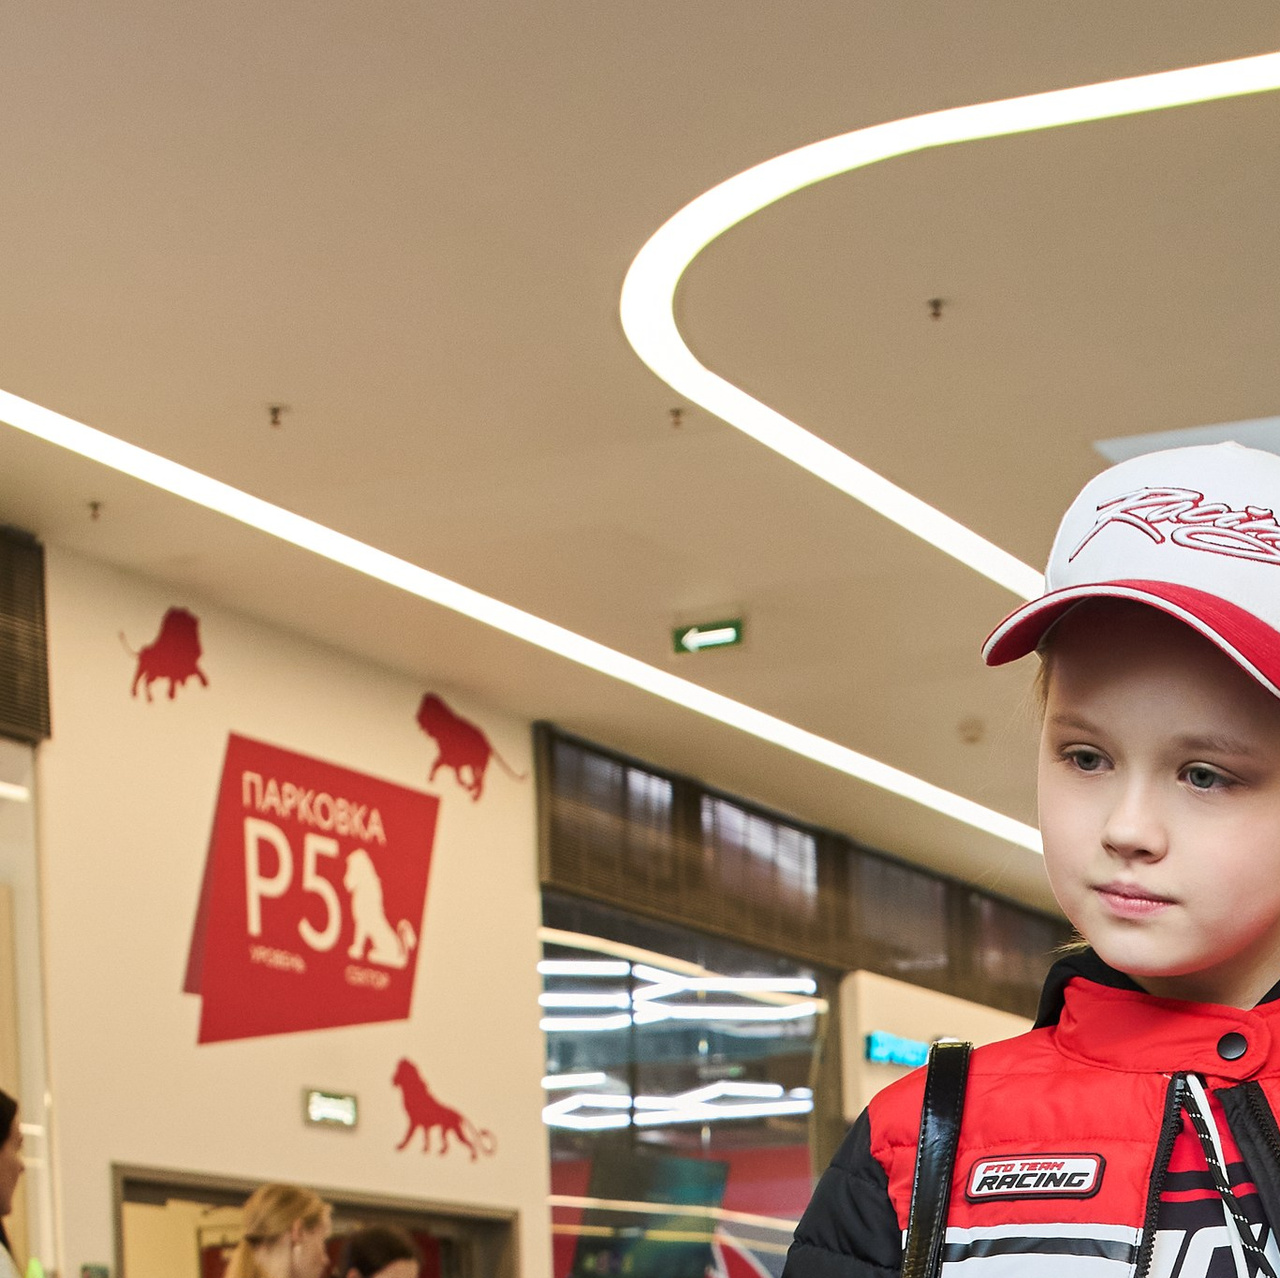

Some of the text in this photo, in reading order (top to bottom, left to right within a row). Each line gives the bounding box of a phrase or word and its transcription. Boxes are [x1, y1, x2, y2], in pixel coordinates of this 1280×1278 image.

[243, 769, 387, 847] ПАРКОВКА
[1020, 1161, 1065, 1171] TEAM
[976, 1172, 1090, 1191] RACING
